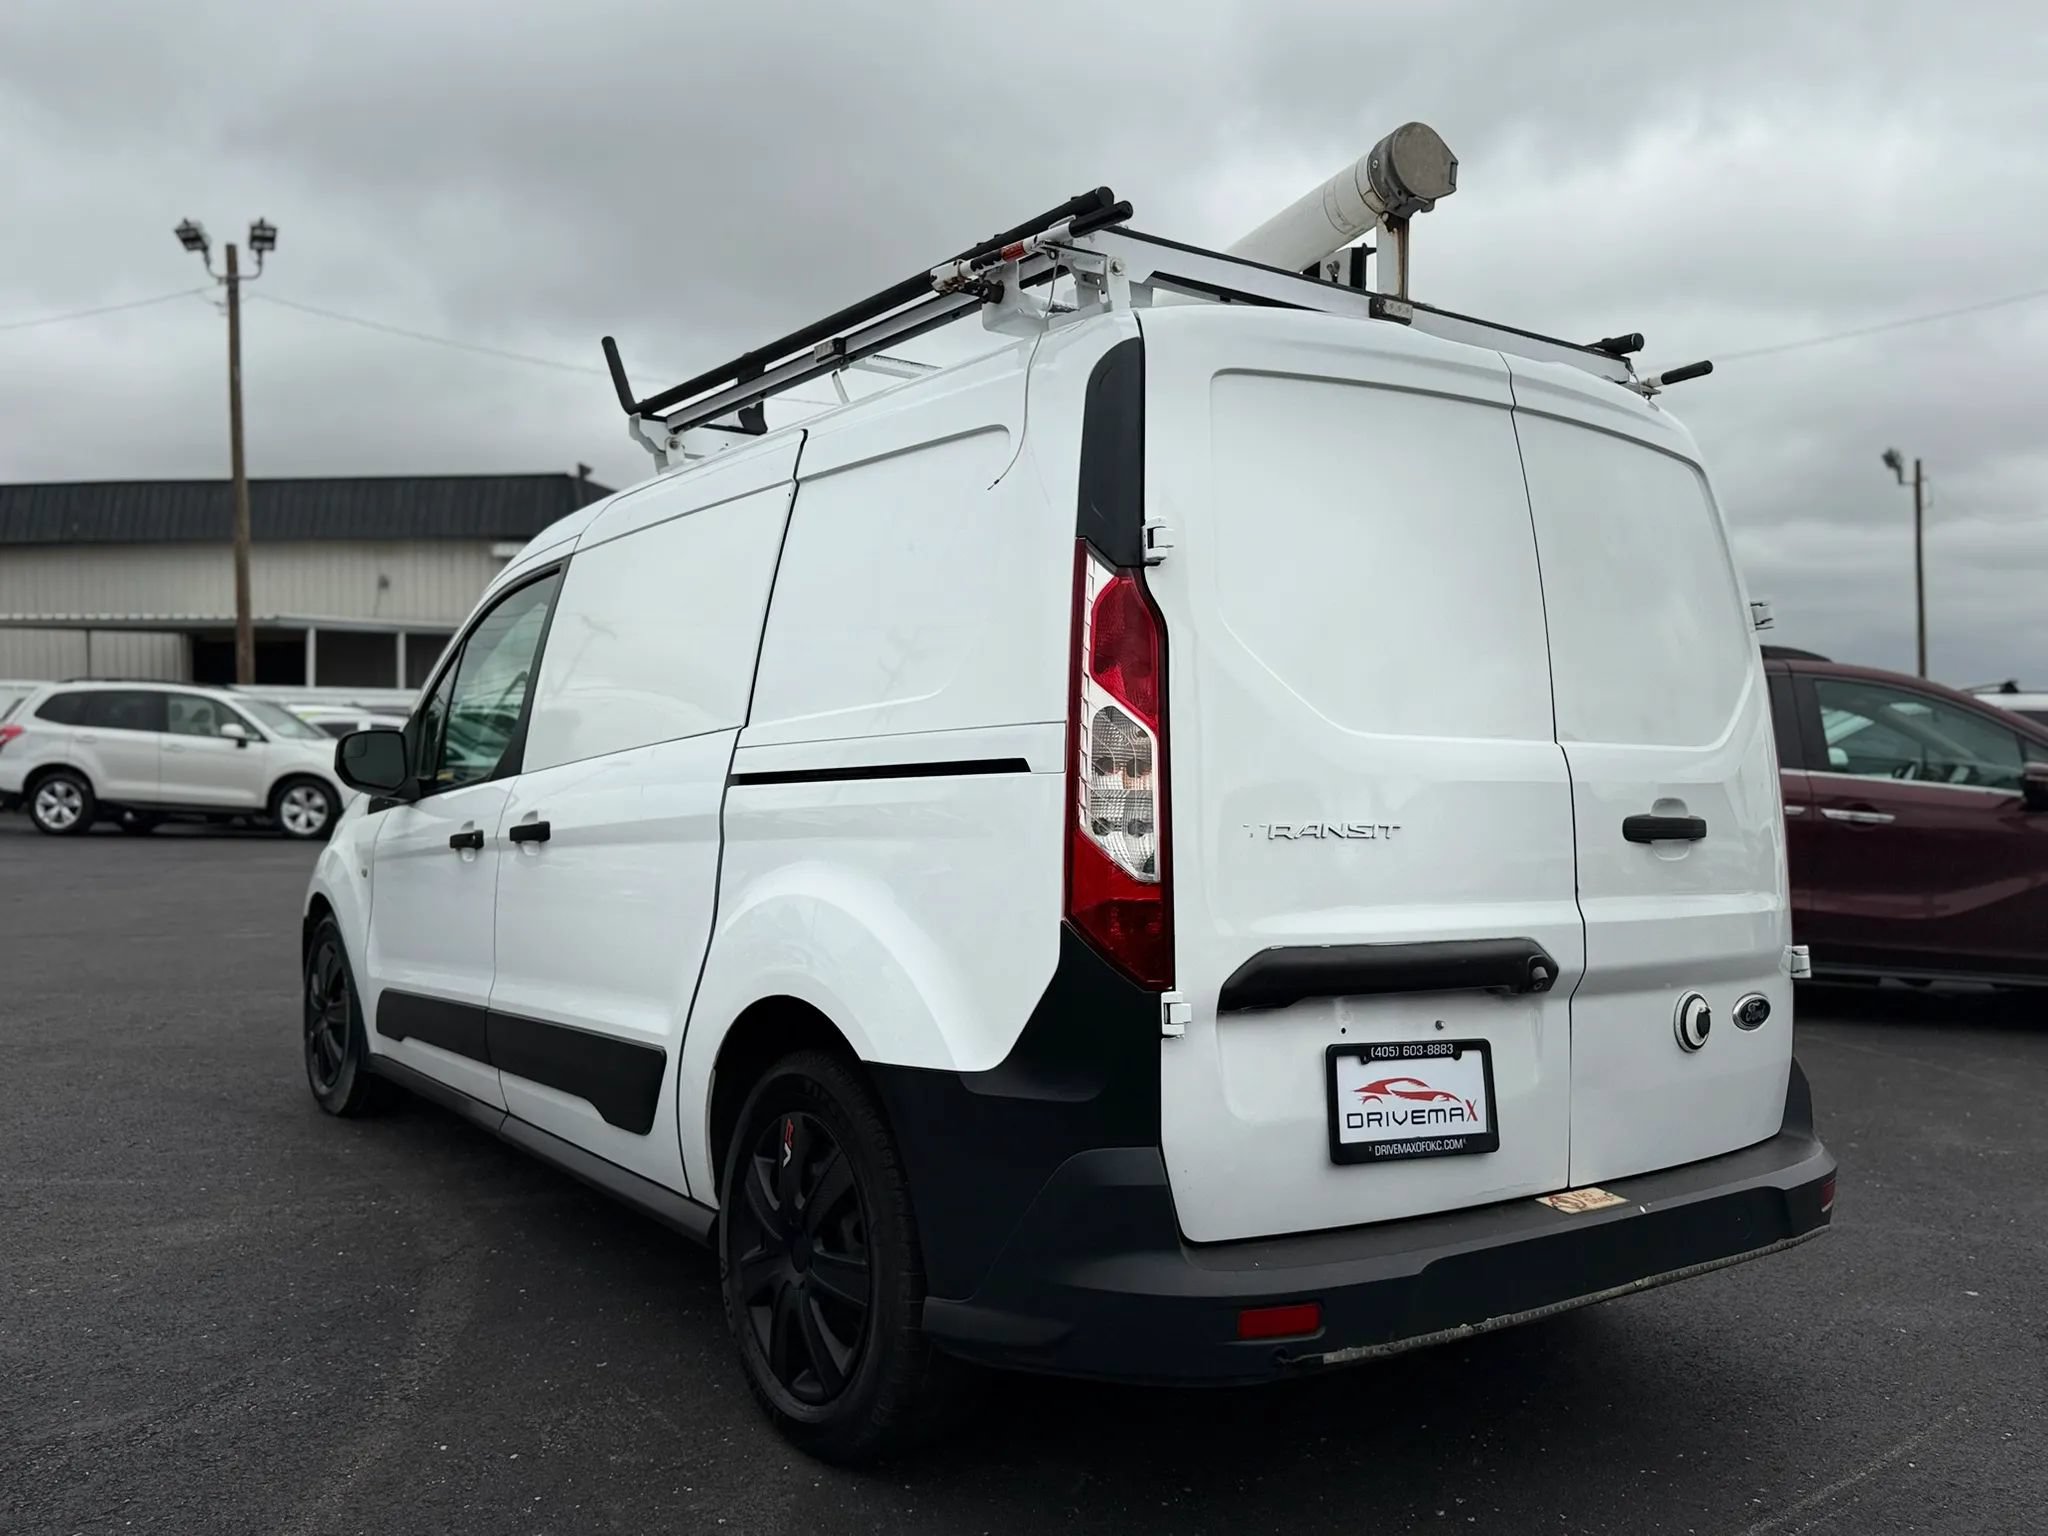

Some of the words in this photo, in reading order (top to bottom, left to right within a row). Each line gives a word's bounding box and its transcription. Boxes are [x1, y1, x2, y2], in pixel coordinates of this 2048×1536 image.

[1242, 823, 1401, 840] TRANSIT
[1370, 1046, 1399, 1058] (405)
[1402, 1043, 1454, 1056] 603-8883
[1347, 1099, 1478, 1128] DRIVEMAX
[1375, 1138, 1463, 1156] DRIVEMAXOFOKC.COM
